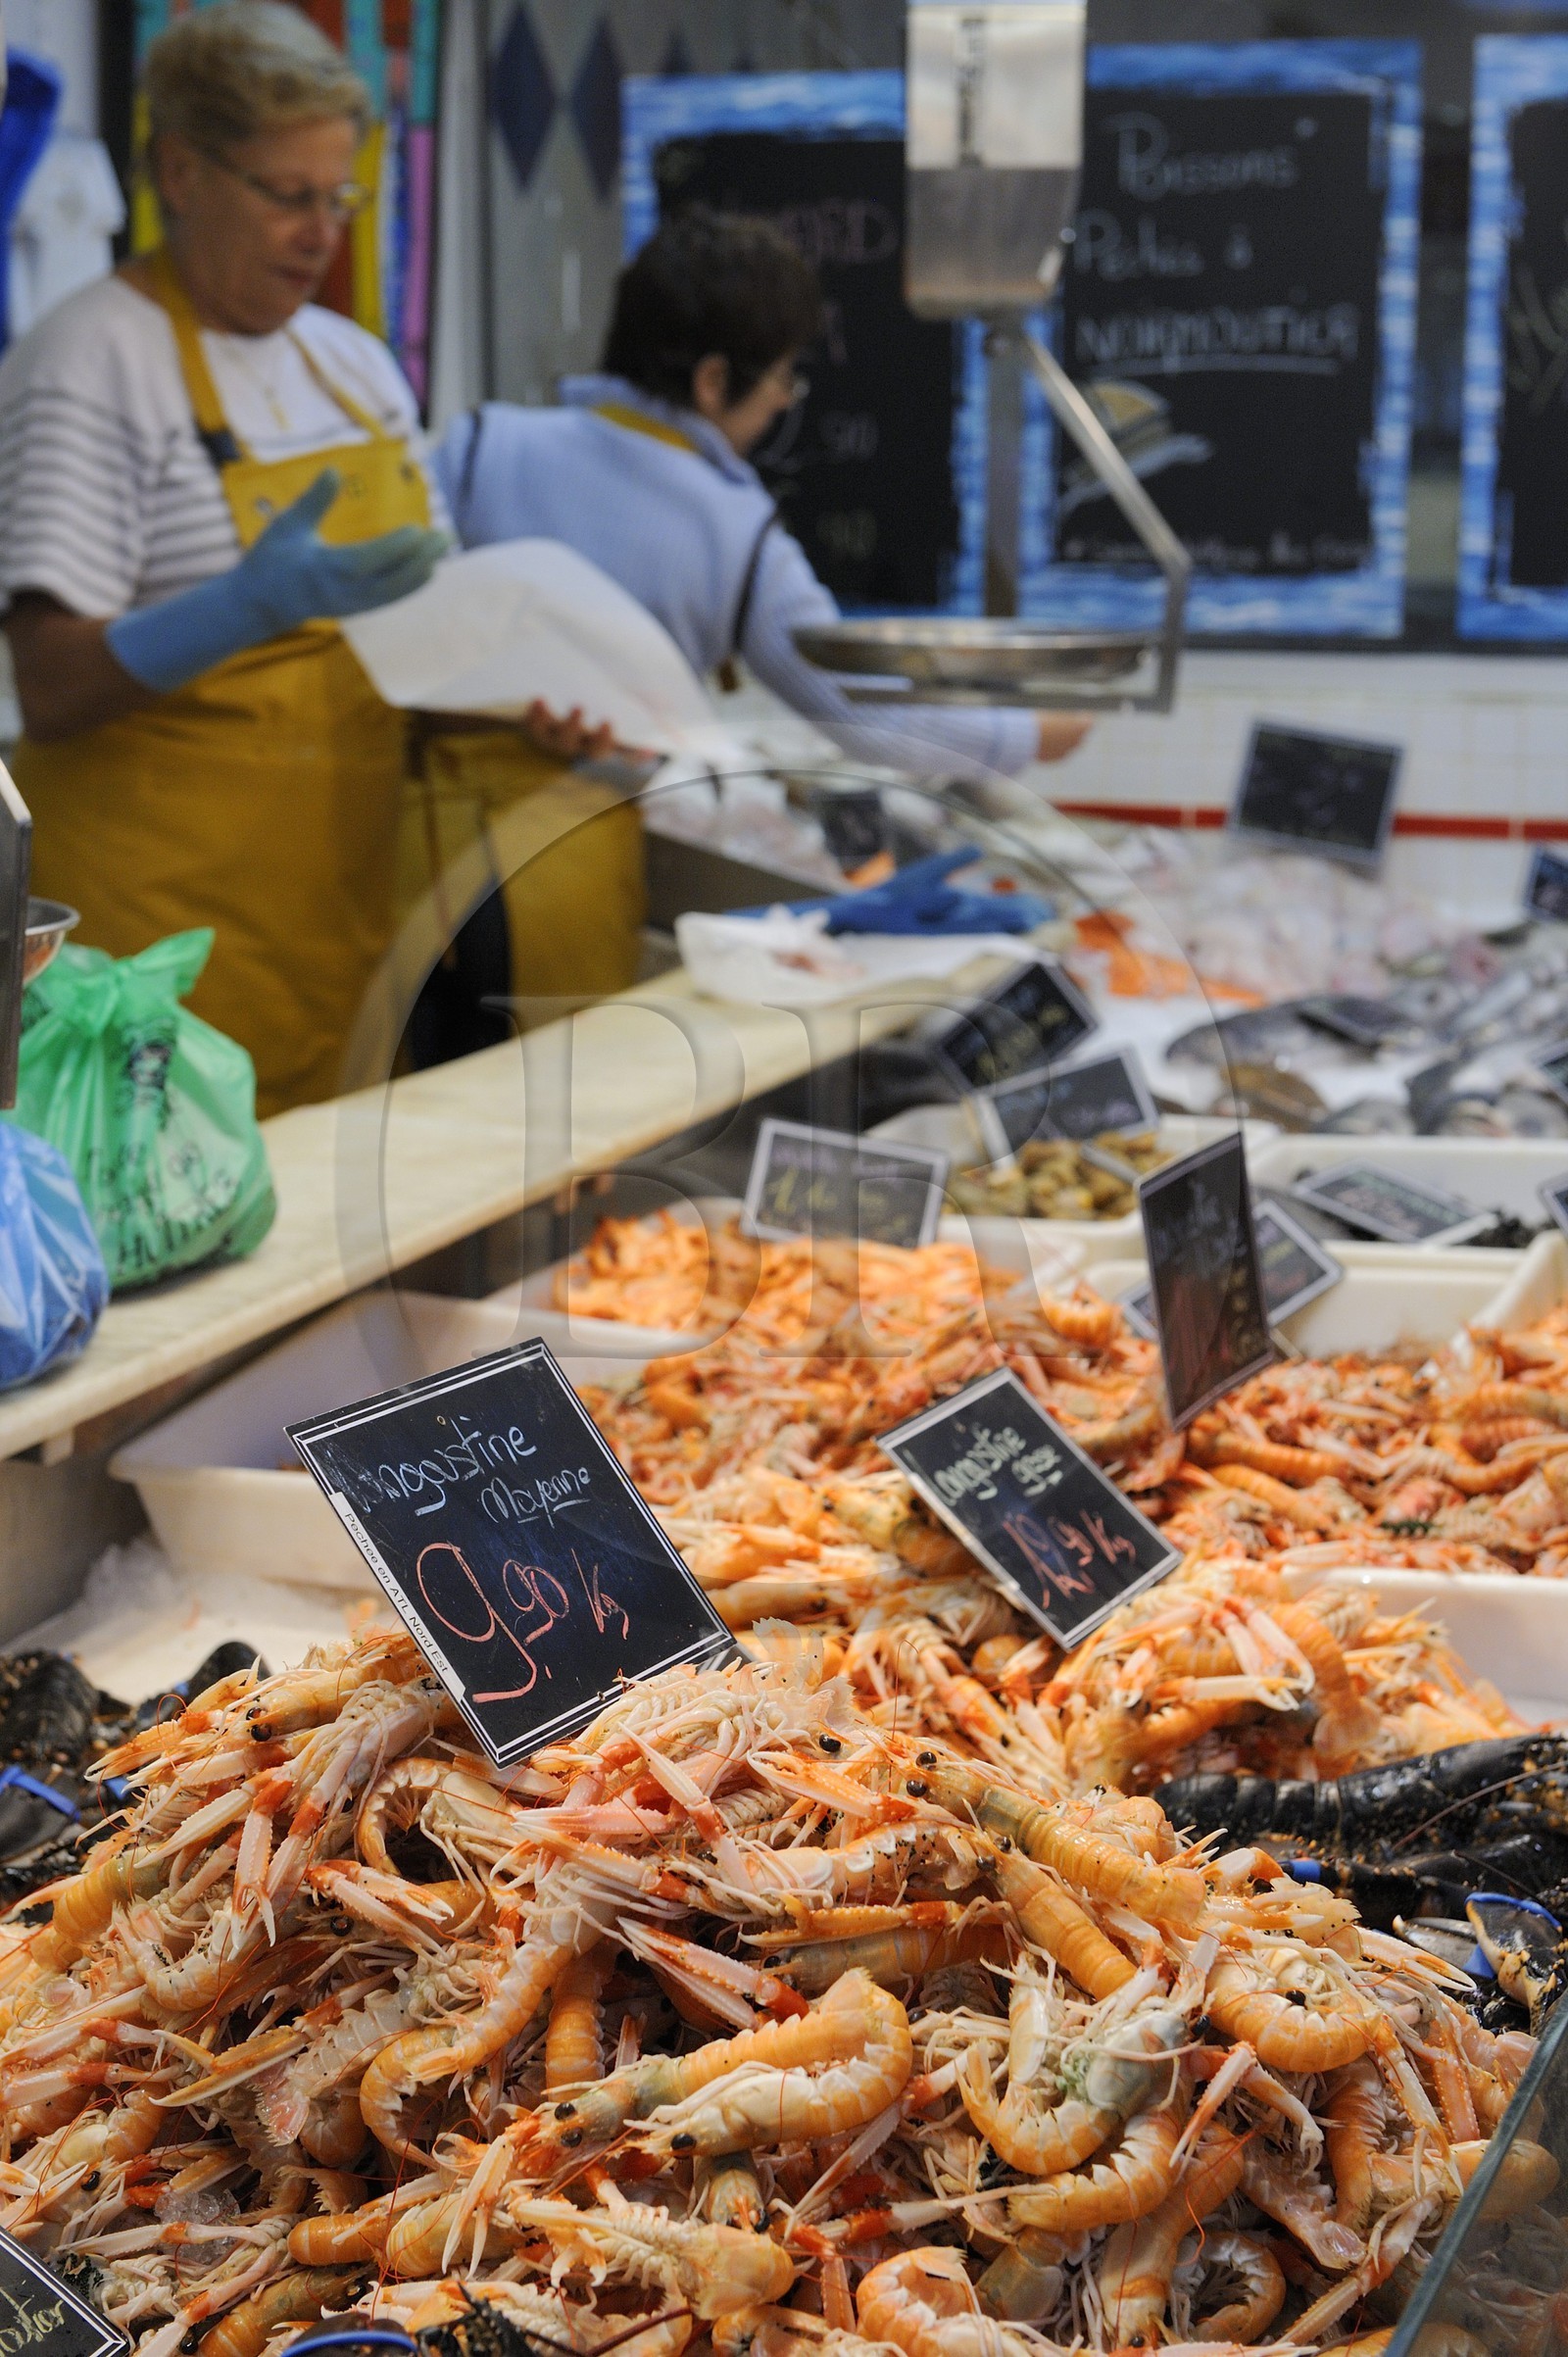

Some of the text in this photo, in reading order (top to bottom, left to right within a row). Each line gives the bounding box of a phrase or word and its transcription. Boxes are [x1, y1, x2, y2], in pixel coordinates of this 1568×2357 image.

[377, 1566, 391, 1585] en
[390, 1587, 408, 1615] ATL
[409, 1616, 434, 1648] Nord
[431, 1650, 450, 1672] Est
